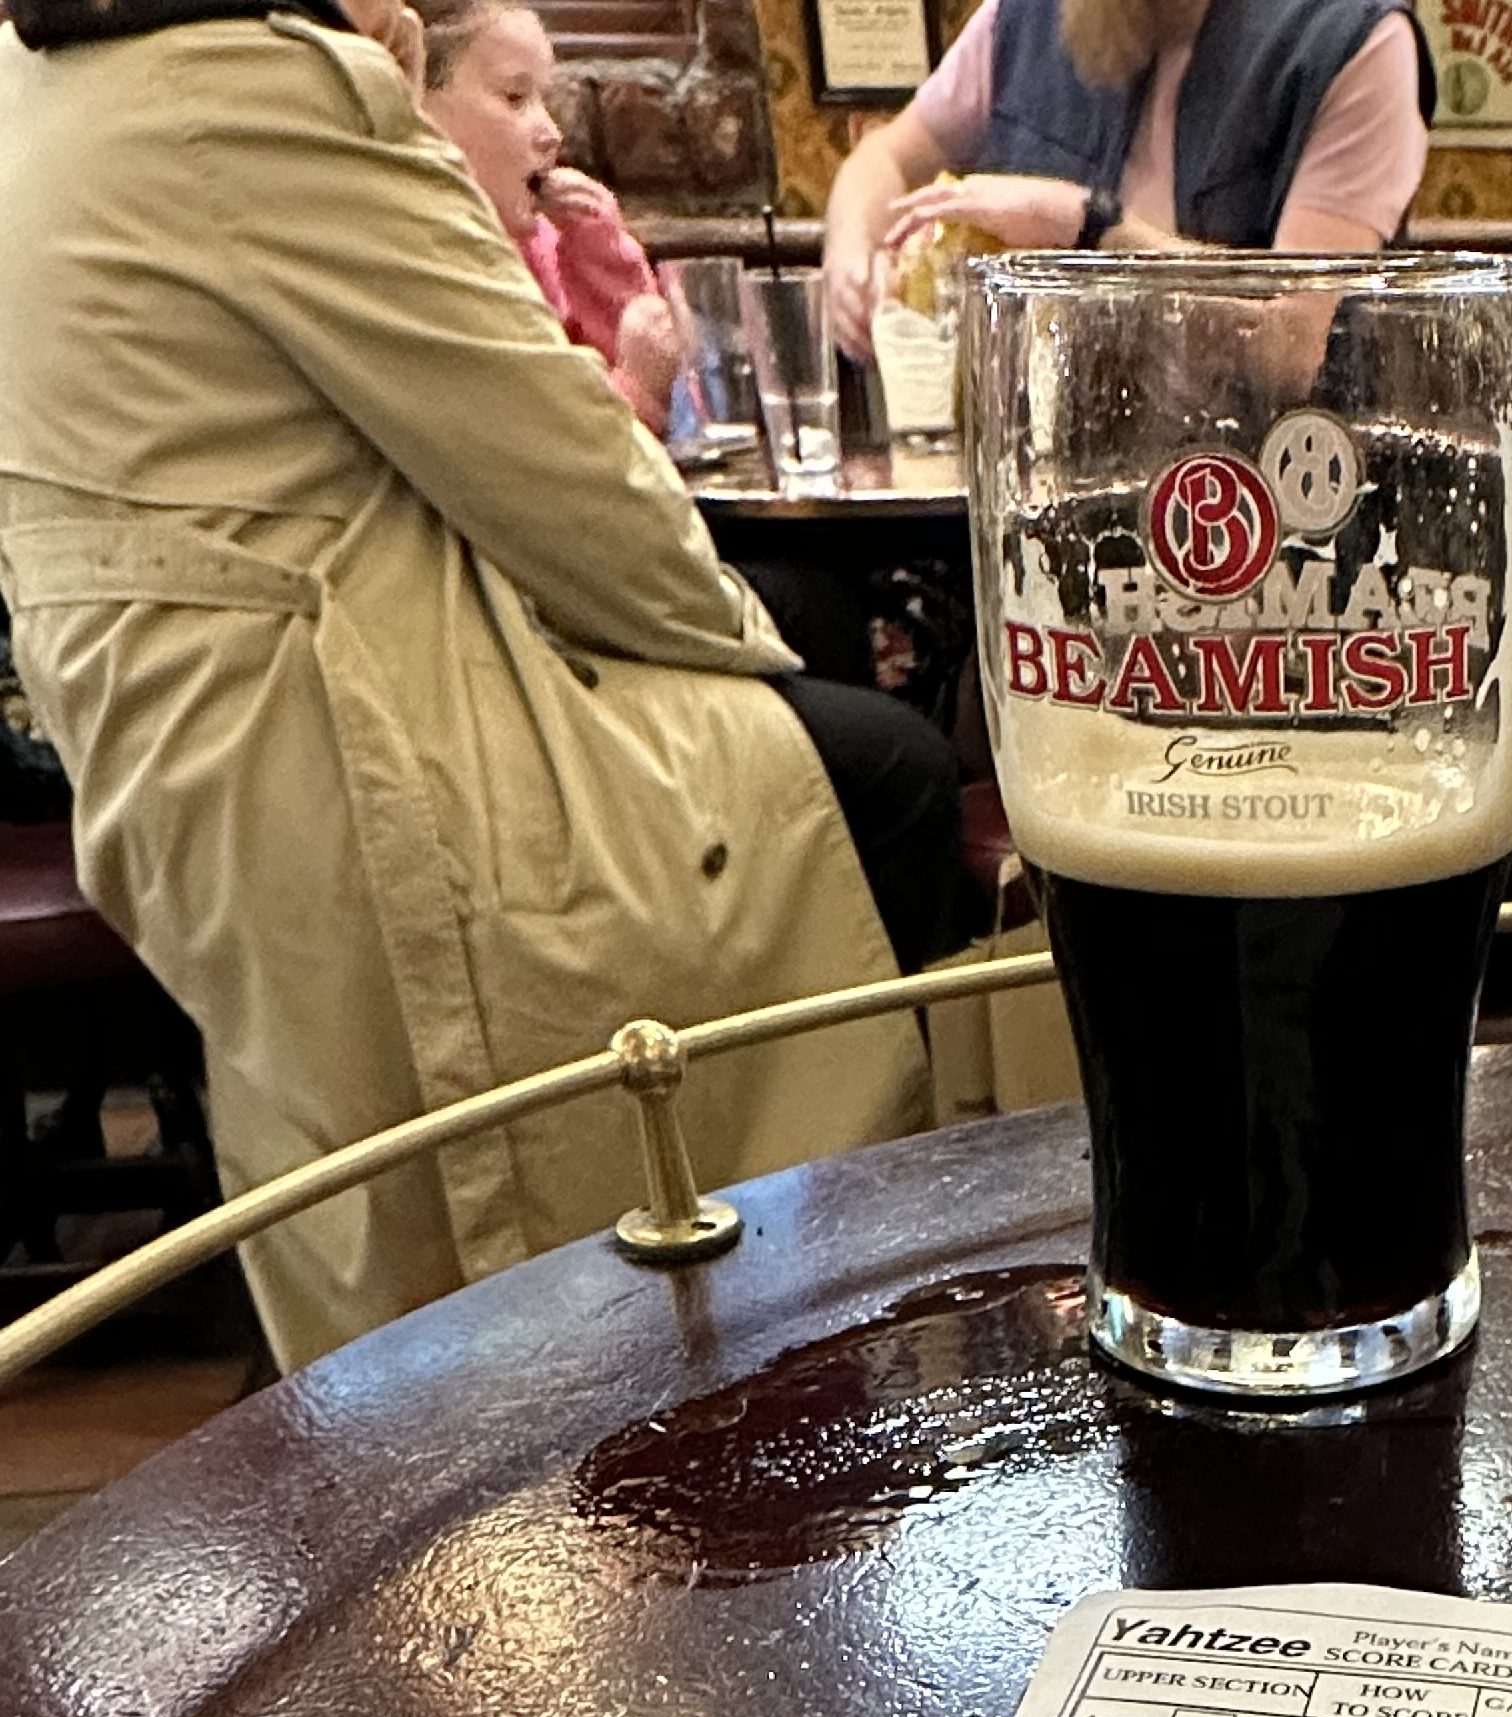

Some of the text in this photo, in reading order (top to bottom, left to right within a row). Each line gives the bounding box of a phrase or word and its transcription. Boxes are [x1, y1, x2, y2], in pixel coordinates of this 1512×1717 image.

[1004, 619, 1472, 718] BEAMISH
[1151, 735, 1298, 783] Genuine
[1126, 789, 1334, 820] IRISH STOUT
[1102, 1616, 1312, 1659] Yahtzee
[1352, 1630, 1451, 1654] Player's
[1324, 1646, 1421, 1670] SCORE
[1102, 1666, 1312, 1700] UPPER SECTION
[1360, 1682, 1430, 1702] HOW
[1332, 1700, 1373, 1717] TO
